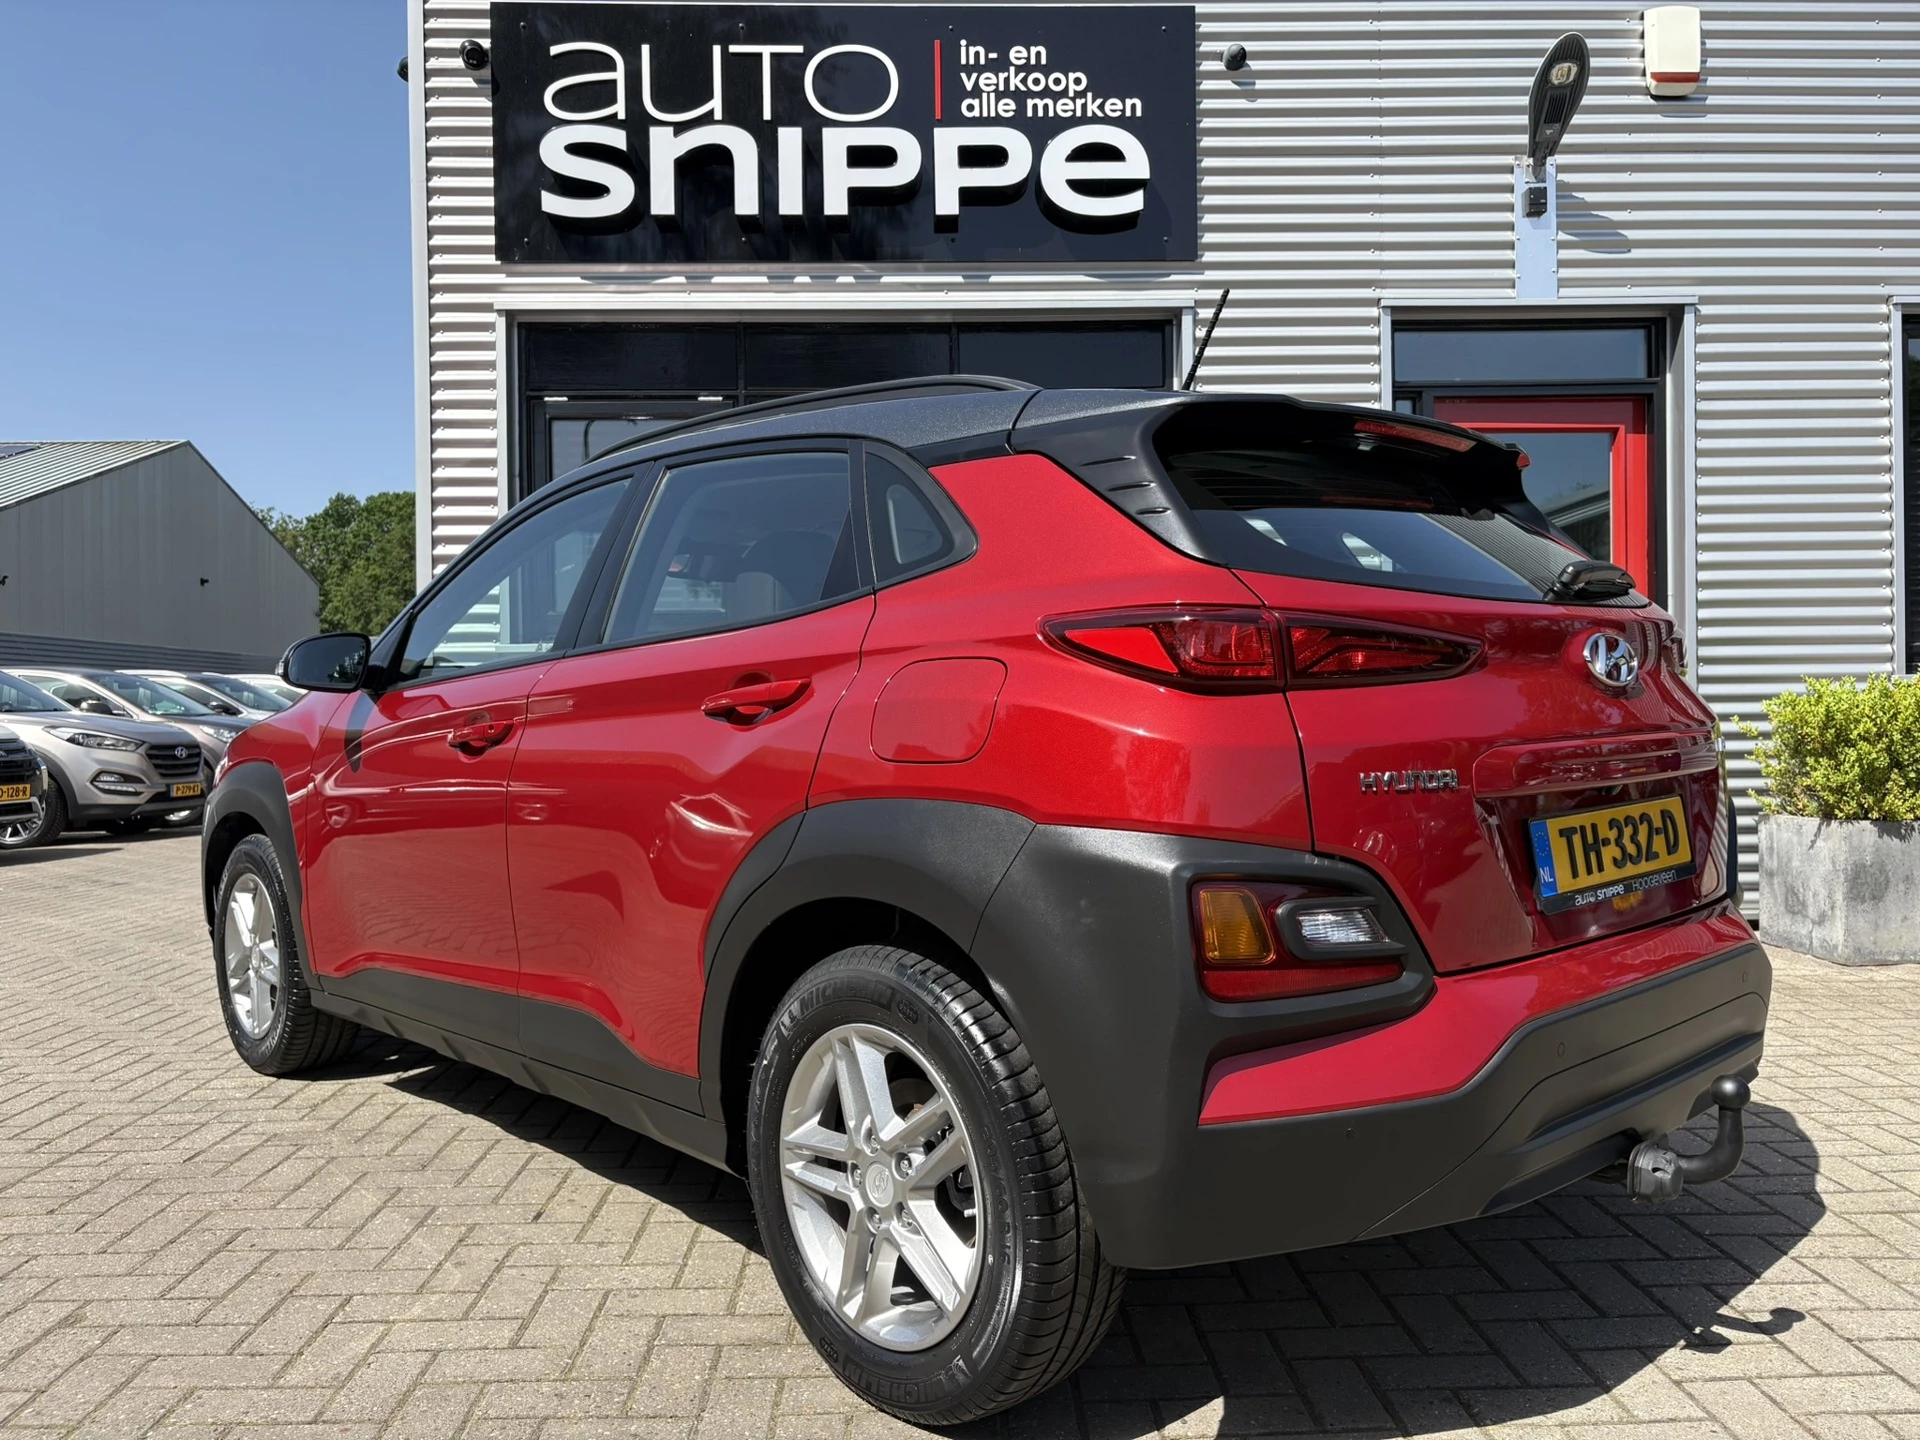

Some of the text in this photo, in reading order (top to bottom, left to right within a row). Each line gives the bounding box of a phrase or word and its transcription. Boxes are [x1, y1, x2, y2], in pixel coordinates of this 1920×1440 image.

[960, 39, 1047, 65] in- en
[960, 66, 1088, 97] verkoop
[960, 92, 1142, 118] alle merken
[1359, 768, 1459, 792] HYUNDAI
[1558, 808, 1680, 879] TH-332-D
[1540, 868, 1554, 883] NL
